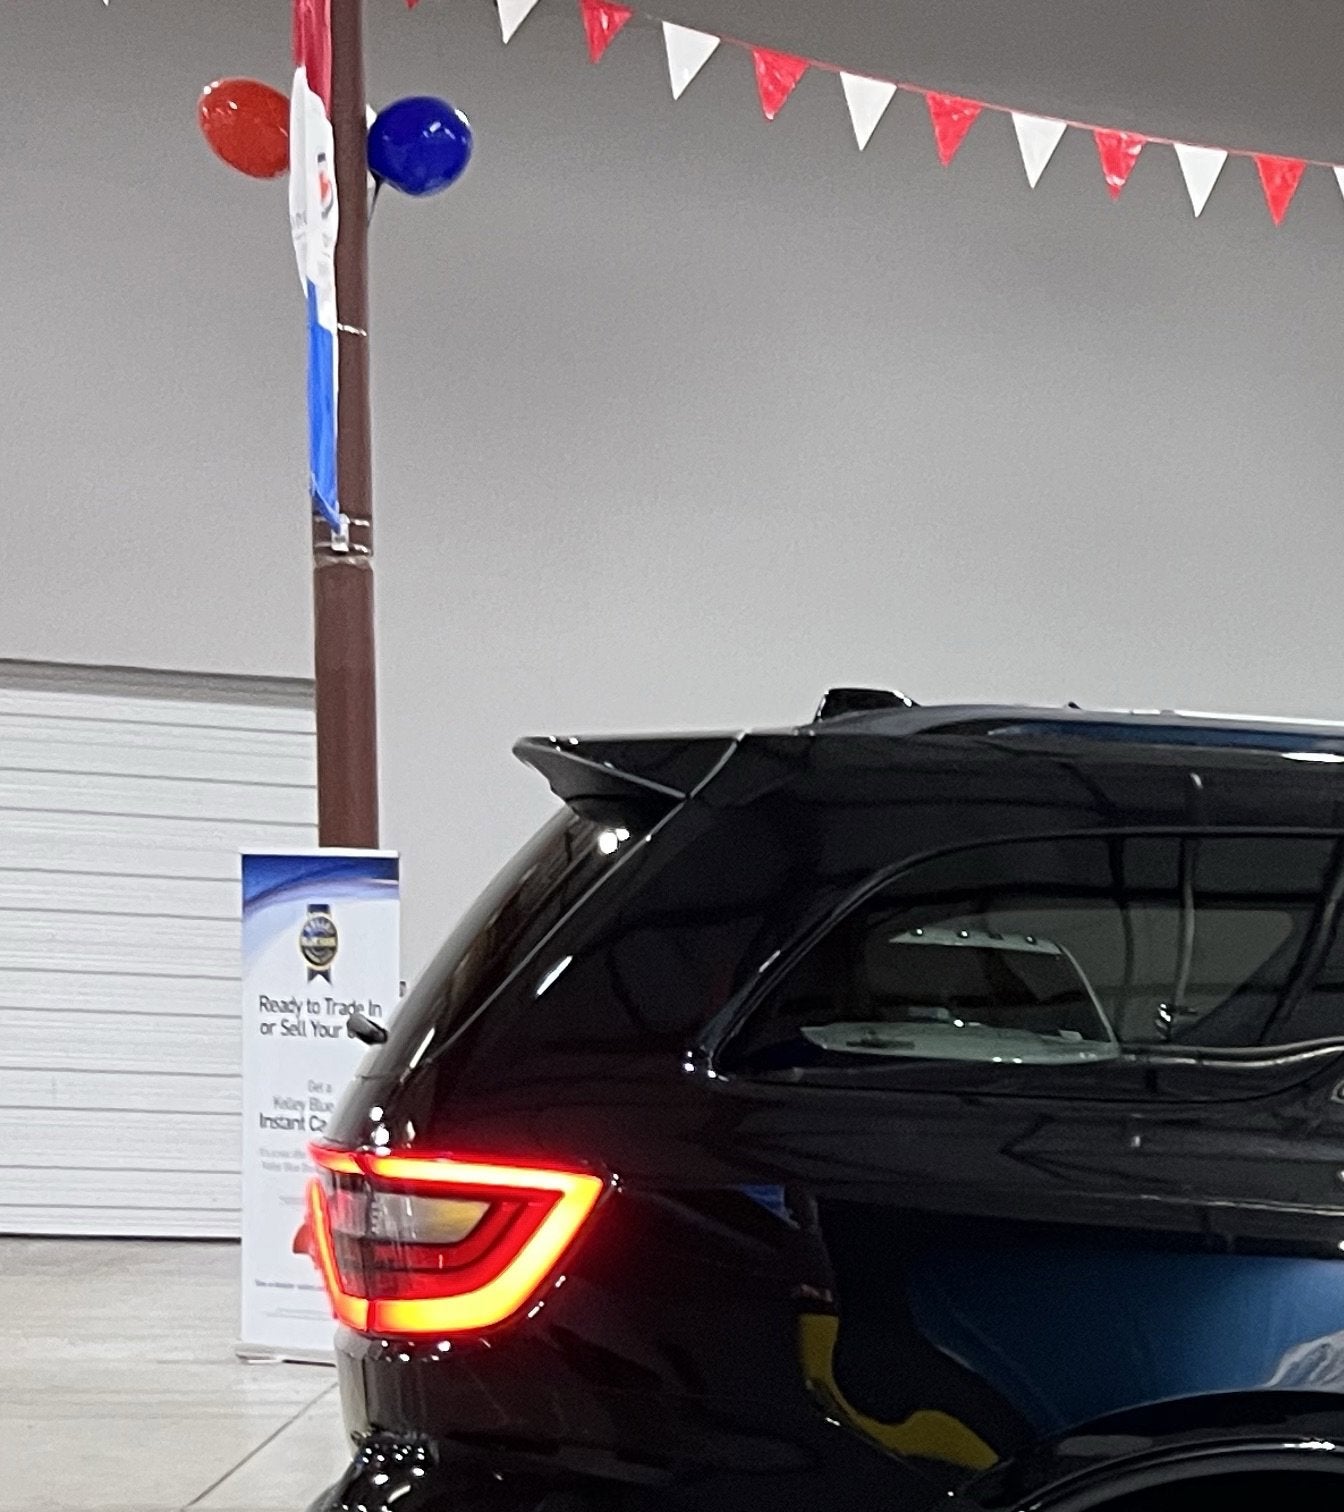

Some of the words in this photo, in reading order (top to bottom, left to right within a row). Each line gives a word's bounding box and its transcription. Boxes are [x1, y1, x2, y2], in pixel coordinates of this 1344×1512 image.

[259, 994, 303, 1019] Ready
[306, 998, 321, 1015] to
[324, 997, 365, 1016] Trade
[368, 999, 382, 1017] In
[260, 1022, 277, 1036] or
[281, 1019, 307, 1037] Sell
[310, 1020, 343, 1039] Your
[259, 1112, 305, 1131] Instant
